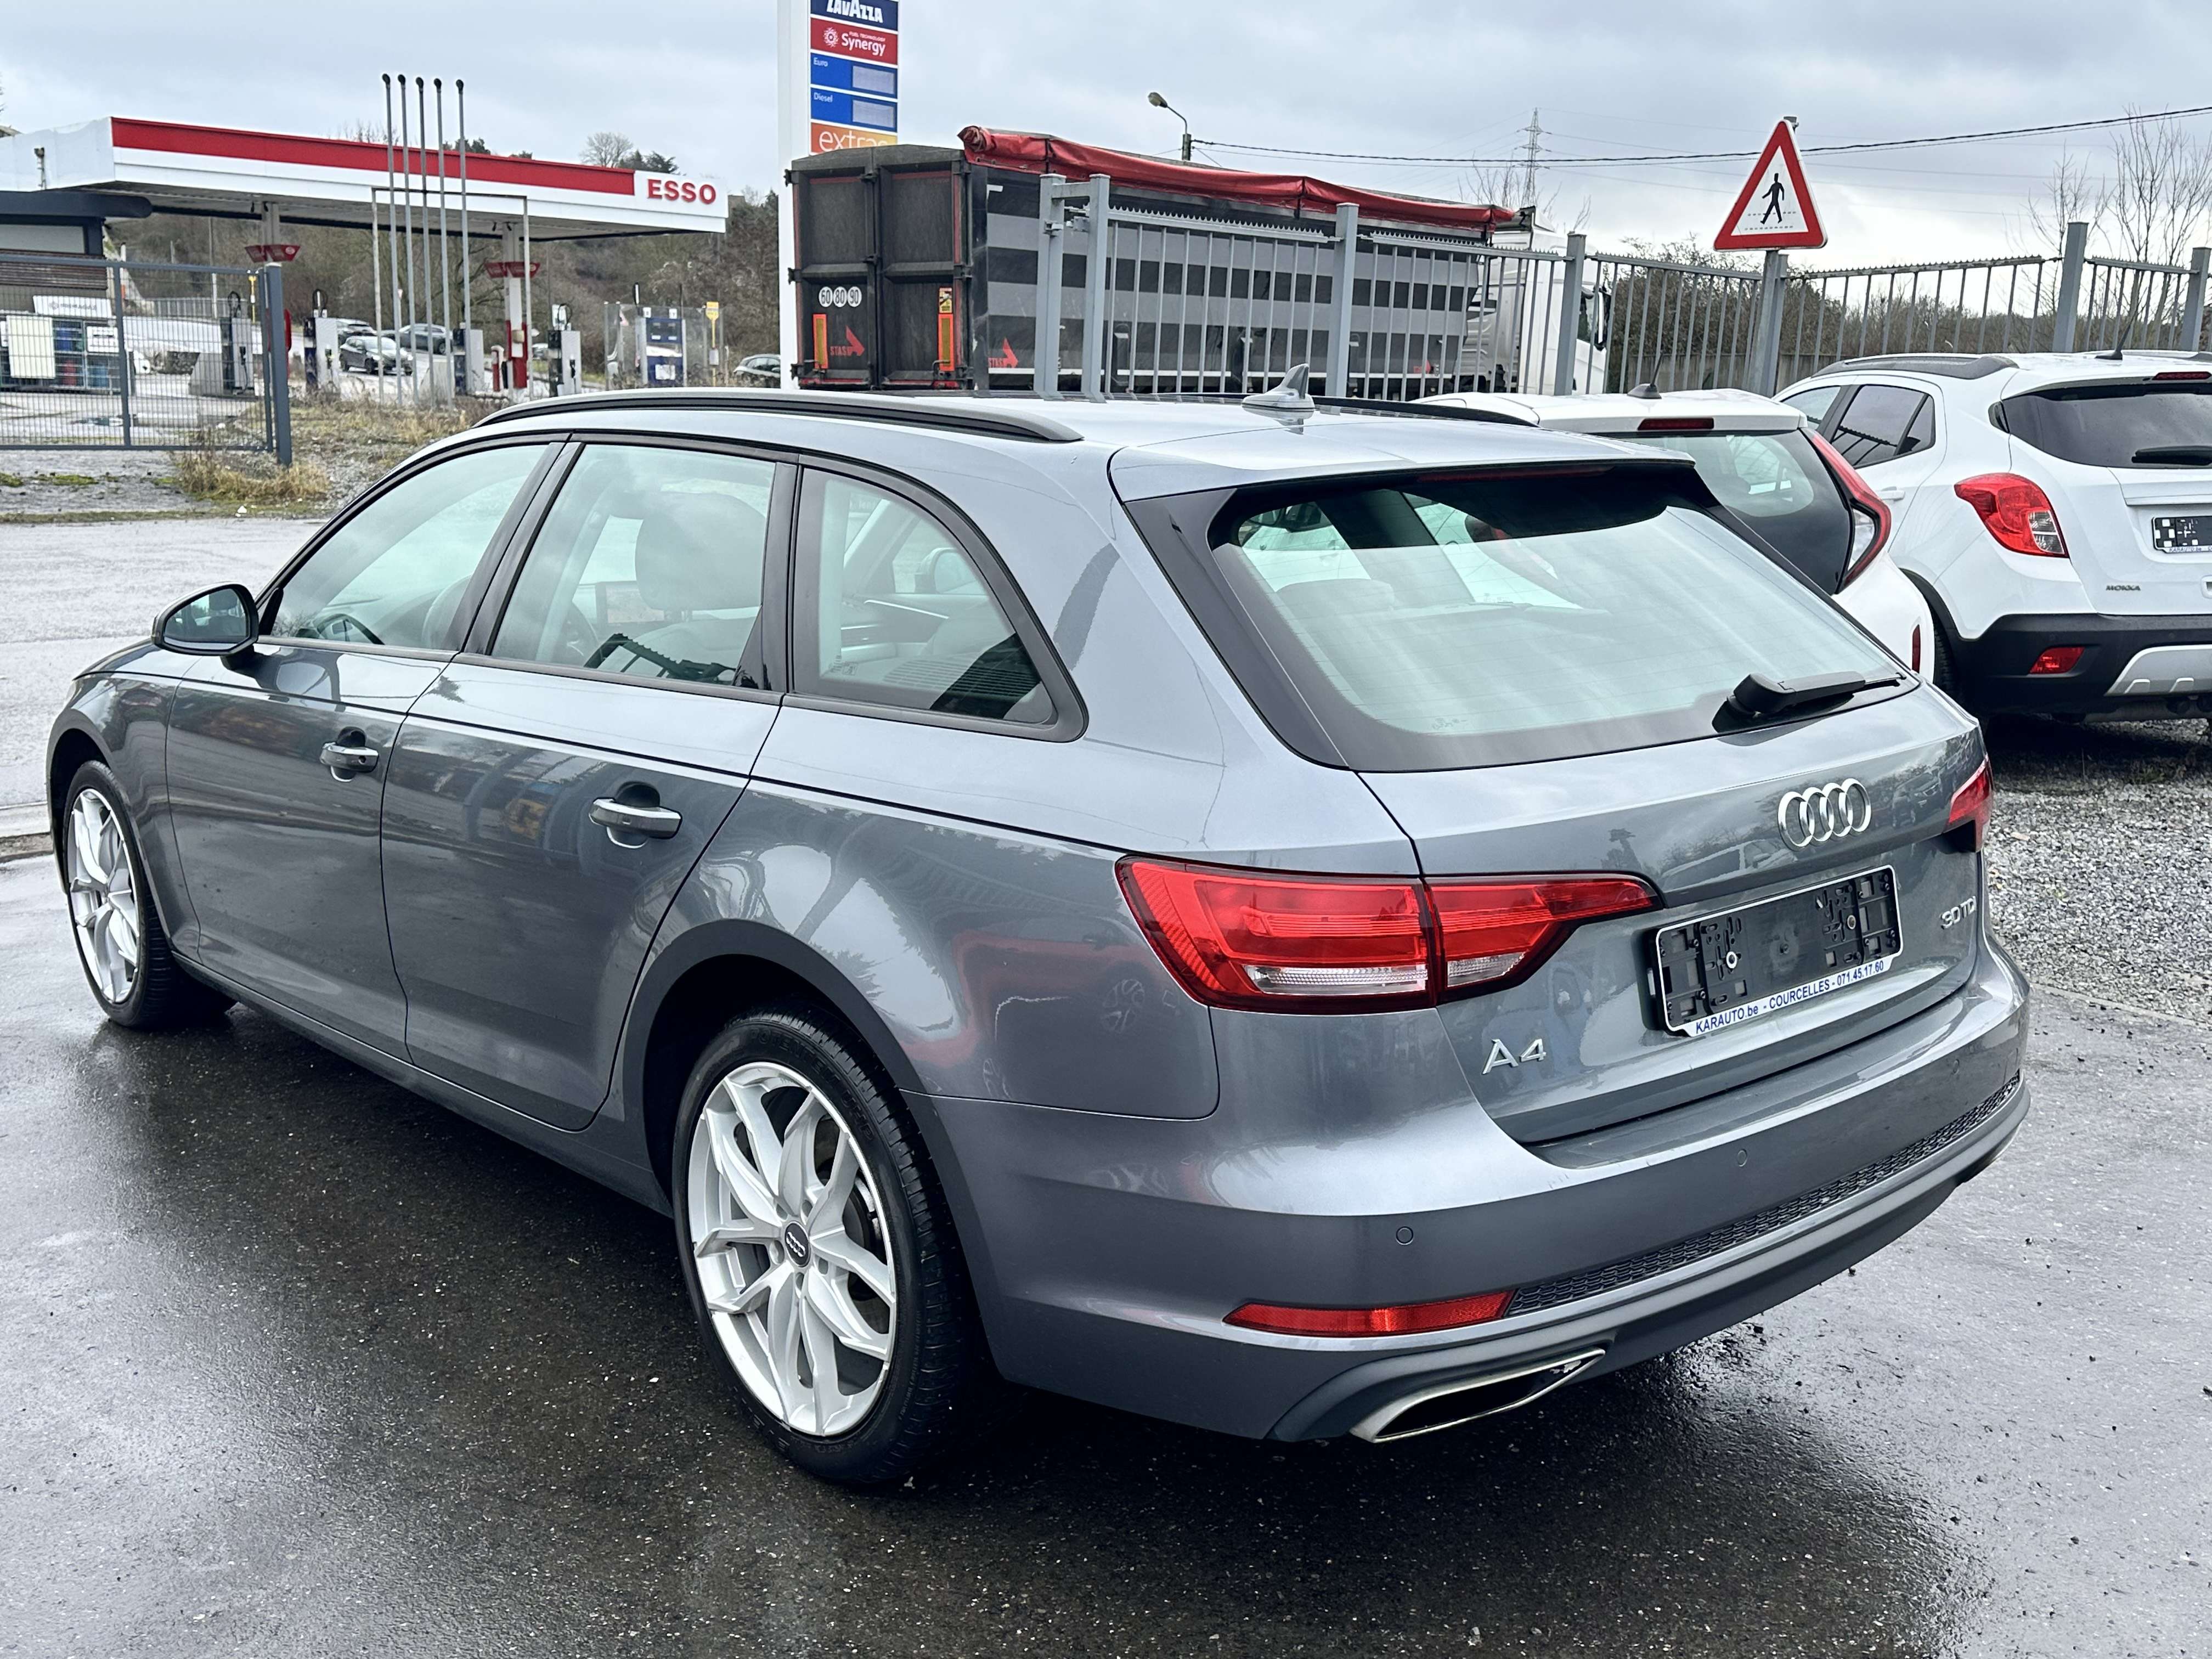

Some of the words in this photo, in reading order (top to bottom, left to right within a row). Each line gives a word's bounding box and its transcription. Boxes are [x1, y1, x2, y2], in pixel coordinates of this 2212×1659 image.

[827, 0, 883, 23] LAVAZZA
[842, 33, 886, 57] Synergy
[813, 57, 828, 67] Euro
[814, 92, 833, 103] Diesel
[647, 178, 716, 205] ESSO
[821, 289, 831, 304] 60
[835, 289, 845, 304] 80
[849, 289, 860, 304] 90
[830, 346, 847, 357] STAS
[1696, 1005, 1758, 1034] KARAUTO.be
[1769, 979, 1830, 1009] COURCELLES
[1837, 960, 1884, 986] 071.45.17.60
[1482, 1039, 1547, 1075] A4
